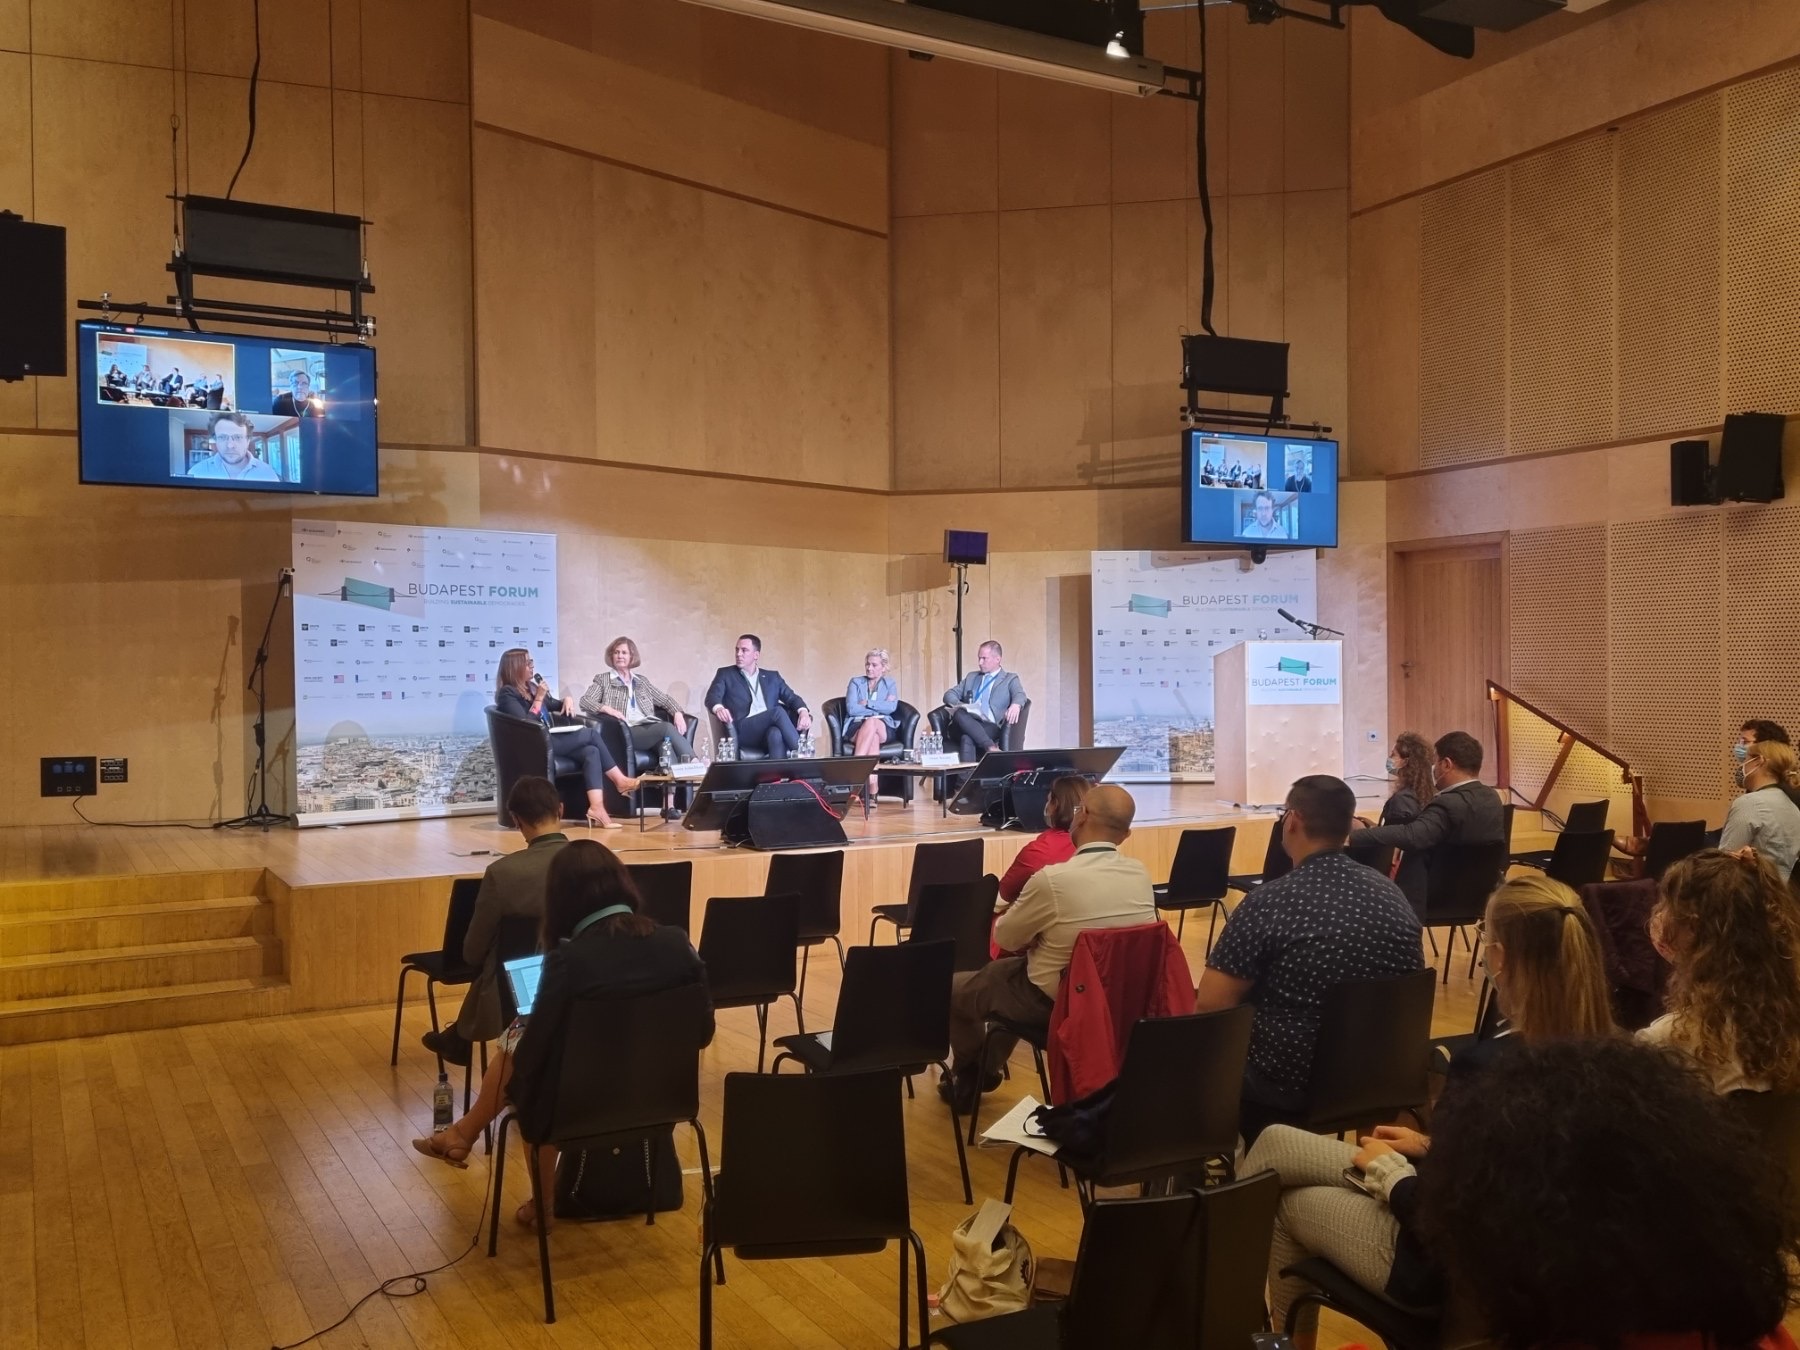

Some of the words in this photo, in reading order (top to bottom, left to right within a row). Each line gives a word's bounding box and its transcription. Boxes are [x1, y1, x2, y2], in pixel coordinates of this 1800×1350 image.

[408, 583, 484, 597] BUDAPEST
[488, 586, 539, 598] FORUM
[1182, 594, 1248, 605] BUDAPEST
[1252, 594, 1299, 604] FORUM
[1251, 678, 1300, 687] BUDAPEST
[1303, 678, 1337, 686] FORUM
